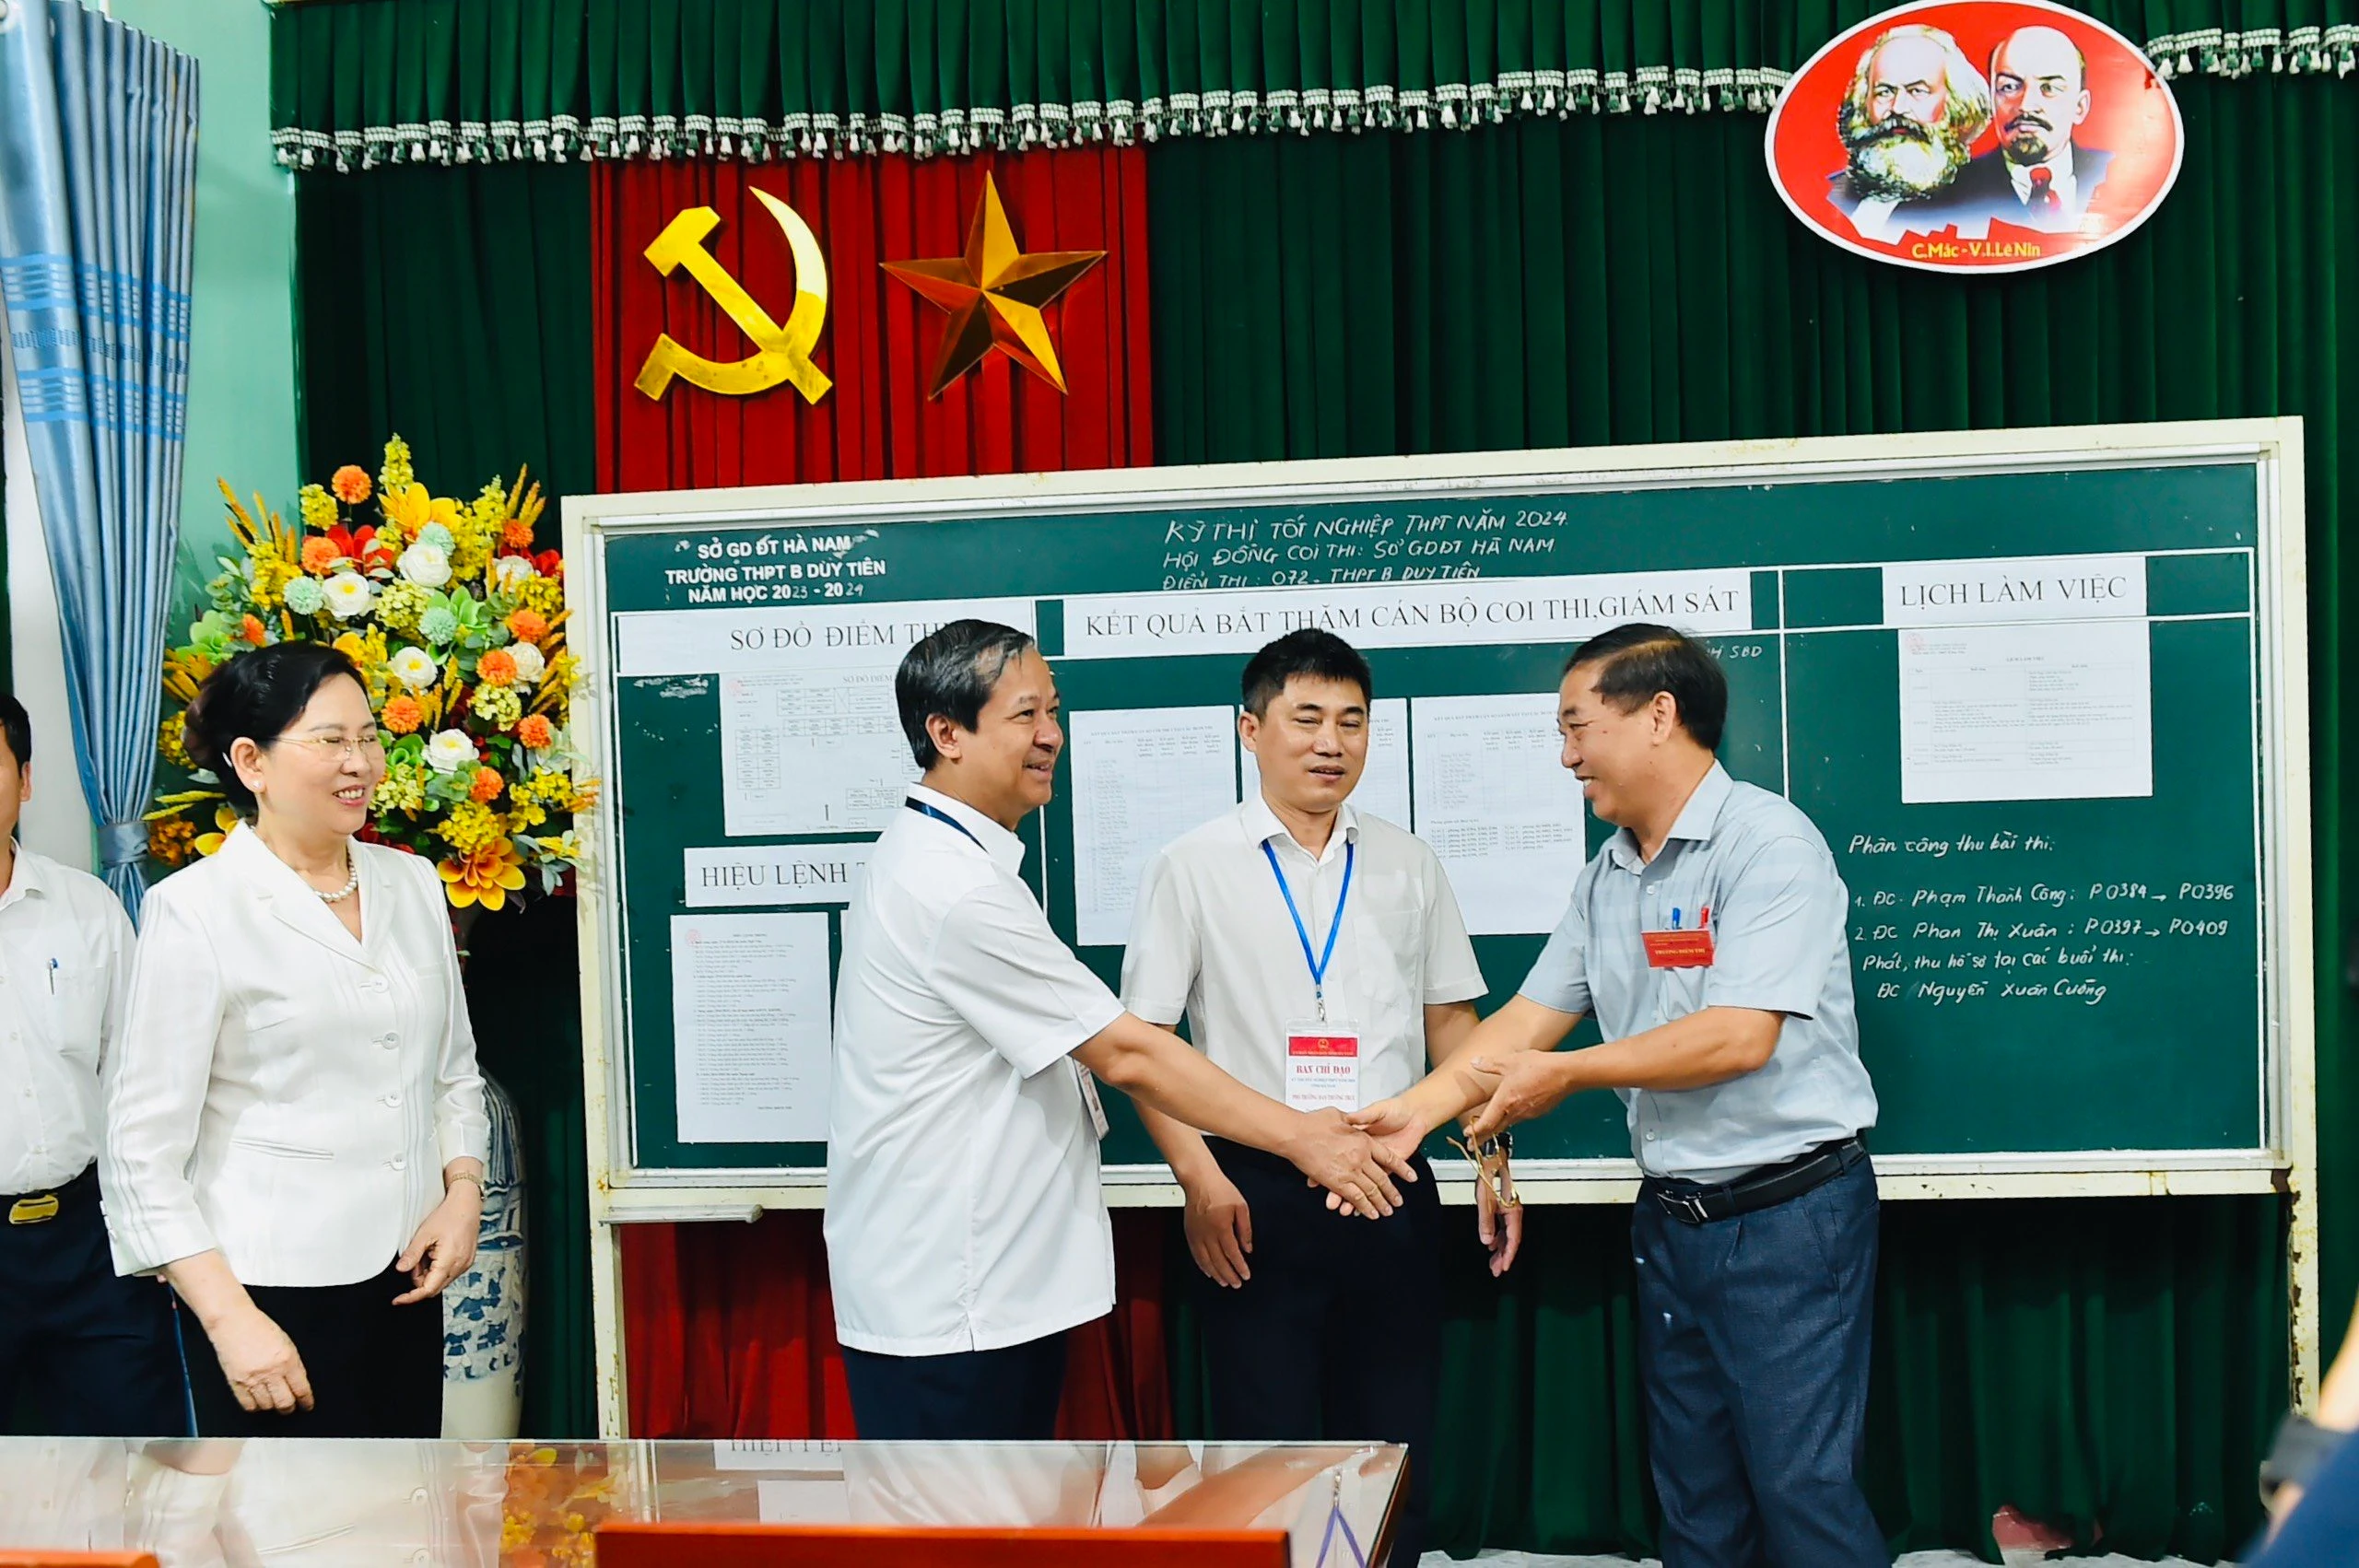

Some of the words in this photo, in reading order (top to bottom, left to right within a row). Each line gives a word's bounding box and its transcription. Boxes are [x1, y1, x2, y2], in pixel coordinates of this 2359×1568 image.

[1270, 514, 1308, 540] TỐT
[1313, 513, 1394, 539] NGHIỆP
[1405, 514, 1452, 535] THPT
[1457, 508, 1506, 532] NĂM
[1515, 510, 1567, 528] 2024
[698, 536, 722, 559] SỞ
[726, 542, 752, 557] GD
[783, 533, 808, 554] HÀ
[812, 535, 851, 552] NAM
[1163, 550, 1199, 572] HỘI
[1212, 544, 1279, 566] ĐỒNG
[1287, 543, 1320, 561] COI
[1471, 537, 1502, 556] HÀ
[1508, 537, 1555, 553] NAM
[664, 563, 738, 584] TRƯỜNG
[741, 565, 786, 580] THPT
[790, 564, 803, 579] B
[846, 556, 886, 577] TIÊN
[1272, 570, 1309, 585] 072
[1331, 568, 1377, 584] THPT
[1381, 566, 1393, 581] B
[1402, 566, 1437, 580] DUY
[1440, 560, 1481, 579] TIÊN
[688, 584, 726, 603] NĂM
[731, 585, 768, 603] HỌC
[1901, 583, 1968, 611] LỊCH
[1979, 575, 2044, 603] LÀM
[2057, 573, 2127, 603] VIỆC
[1086, 608, 1139, 637] KẾT
[1146, 607, 1205, 640] QUẢ
[1215, 605, 1271, 635] BẮT
[1278, 603, 1360, 630] THĂM
[1371, 599, 1429, 627] CÁN
[1439, 596, 1478, 628] BỘ
[1485, 600, 1534, 624] COI
[1684, 585, 1740, 614] SÁT
[730, 626, 764, 650] SƠ
[771, 620, 812, 649] ĐỒ
[824, 618, 895, 647] ĐIỂM
[904, 622, 949, 644] TH
[1730, 645, 1762, 659] SBD
[1848, 835, 1897, 854] Phân
[1904, 837, 1949, 858] công
[1956, 834, 1984, 851] thu
[1989, 831, 2018, 850] bài
[701, 862, 766, 890] HIỆU
[774, 860, 848, 889] LỆNH
[1911, 889, 1966, 908] Phạm
[1977, 885, 2023, 904] Thành
[2177, 882, 2235, 901] P0396
[1912, 921, 1961, 940] Phan
[1977, 921, 2000, 942] Thị
[2008, 922, 2057, 939] Xuân
[2168, 918, 2229, 937] P0409
[1914, 954, 1941, 969] thu
[1947, 952, 1972, 969] hồ
[1972, 954, 1988, 968] sơ
[1994, 950, 2016, 975] tại
[2058, 944, 2097, 965] buổi
[1918, 980, 1989, 1006] Nguyễn
[2001, 982, 2048, 998] Xuân
